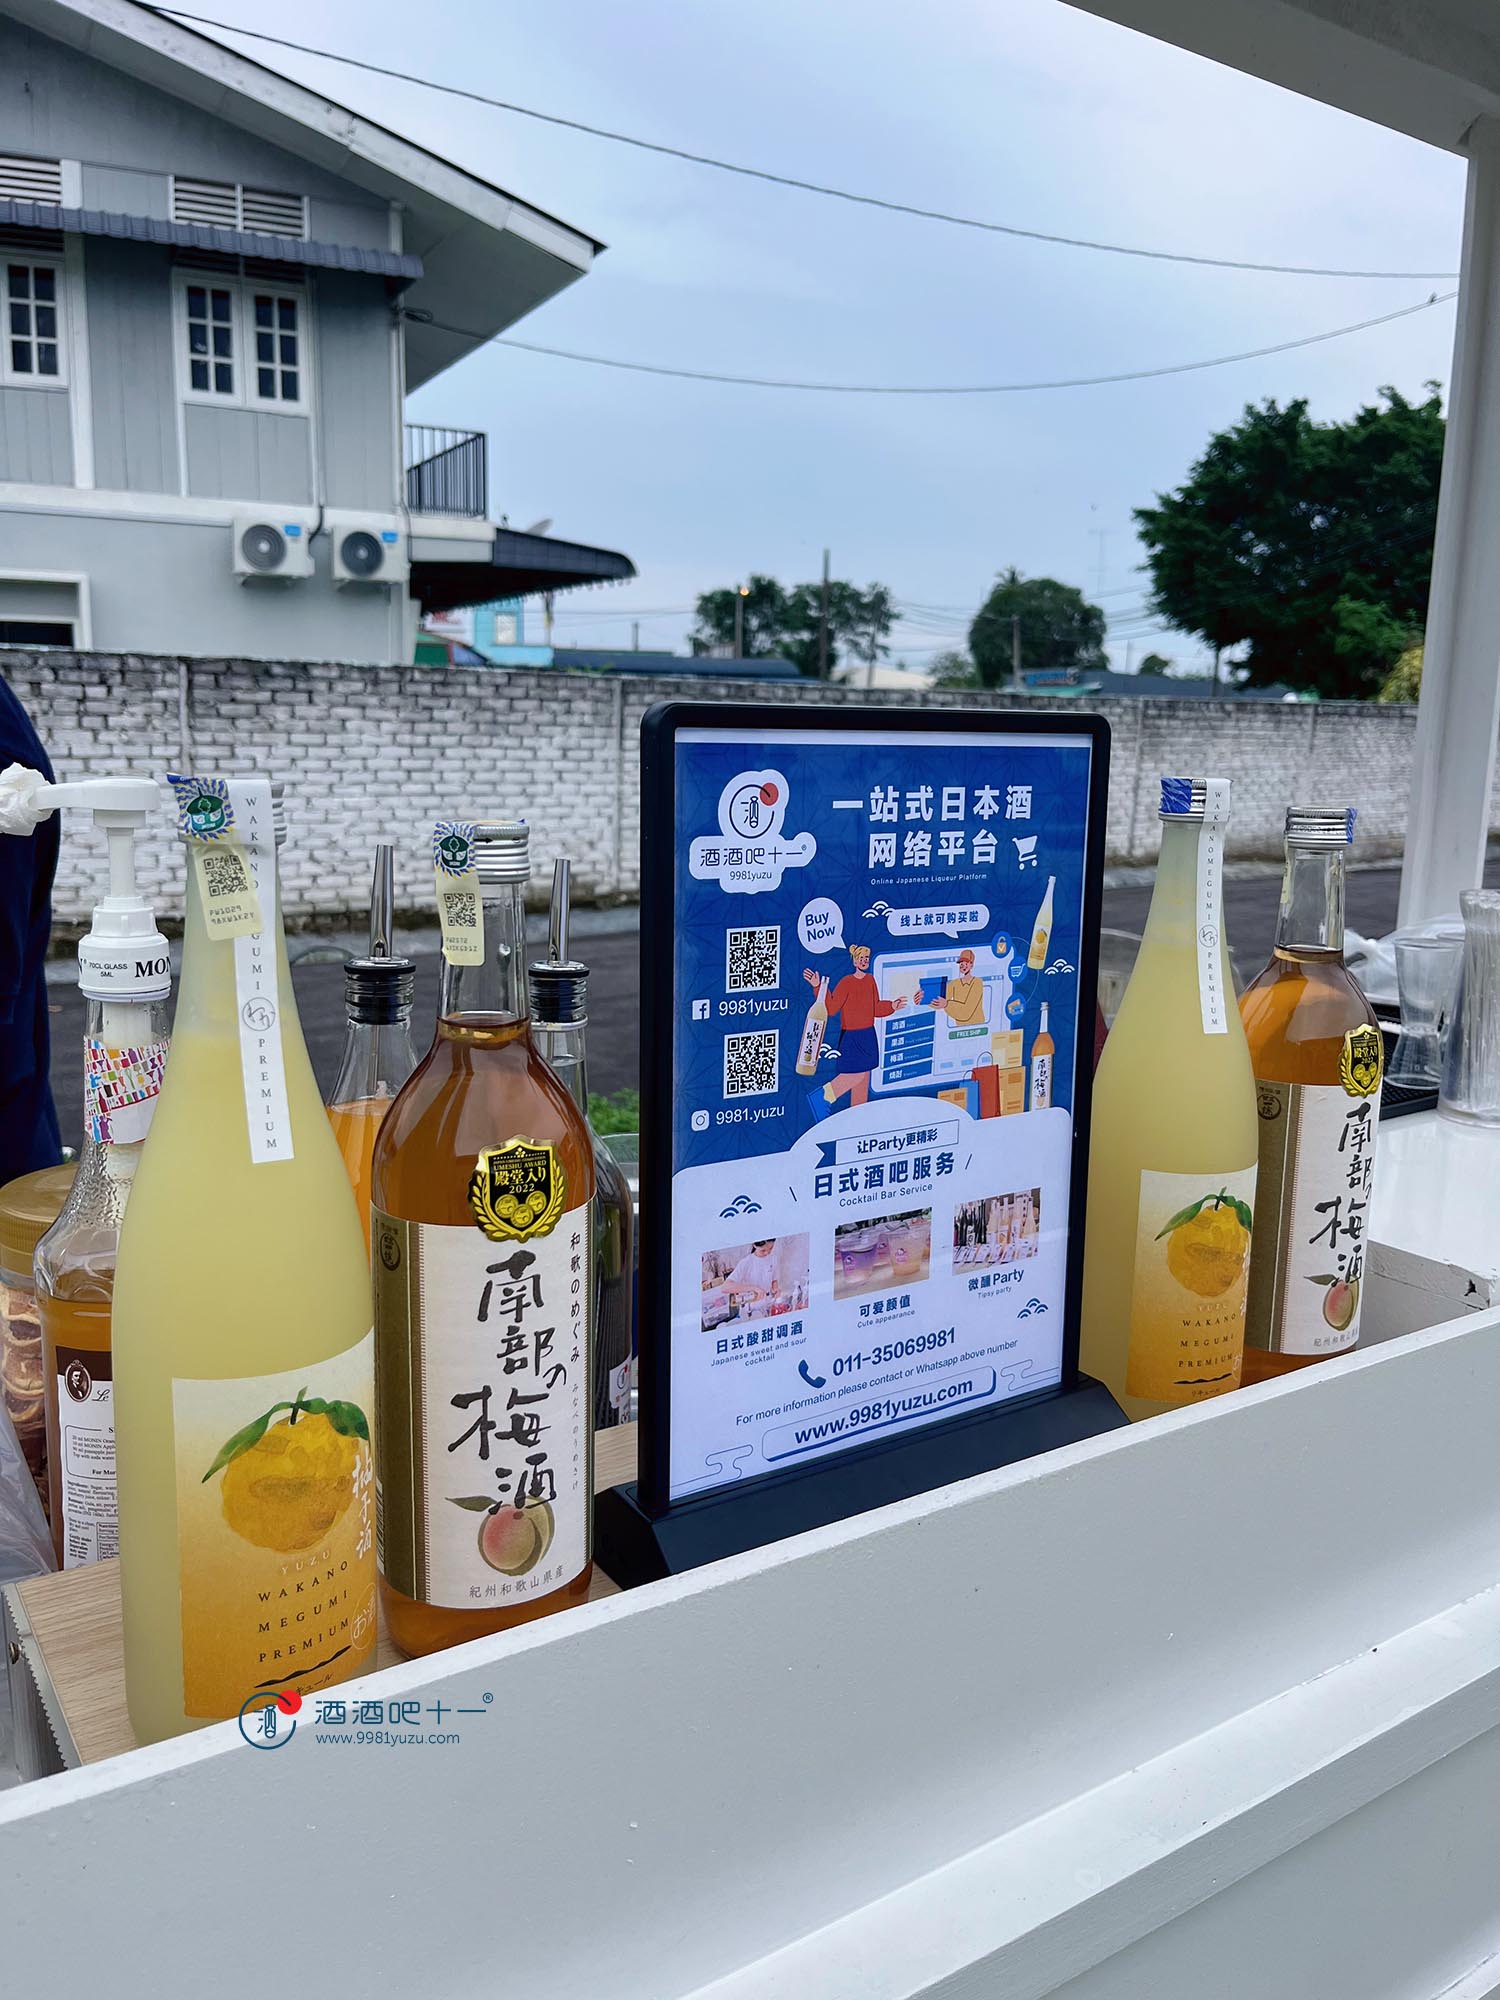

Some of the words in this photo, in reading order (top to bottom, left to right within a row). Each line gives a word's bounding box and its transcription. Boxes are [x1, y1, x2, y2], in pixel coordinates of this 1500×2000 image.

[832, 784, 1033, 823] 一站式日本酒
[868, 828, 998, 869] 网络平台
[729, 870, 772, 882] 9981yuzu
[871, 877, 894, 886] Online
[896, 876, 929, 885] Japanese
[931, 874, 957, 883] Liqueur
[959, 873, 987, 881] Platform
[805, 912, 830, 927] Buy
[900, 910, 979, 927] 线上就可购买啦
[807, 925, 836, 942] Now
[719, 999, 788, 1016] 9981yuzu
[258, 1038, 277, 1148] PREMIUM
[716, 1106, 785, 1125] 9981.yuzu
[857, 1128, 938, 1154] 让Party更精彩
[495, 1166, 547, 1186] 殿堂入り
[524, 1160, 547, 1168] AWARD
[814, 1152, 955, 1199] 日式酒吧服务
[509, 1184, 535, 1194] 2022
[839, 1192, 878, 1207] Cocktail
[880, 1189, 896, 1200] Bar
[899, 1183, 933, 1196] Service
[570, 1232, 581, 1363] 和歌のめぐみ
[978, 1291, 994, 1299] Tipsy
[995, 1286, 1012, 1295] party
[859, 1294, 911, 1317] 可爱颜值
[857, 1319, 873, 1329] Cute
[875, 1310, 915, 1324] appearance
[1182, 1313, 1236, 1327] WAKANO
[717, 1320, 803, 1354] 日式酸甜调酒
[1180, 1333, 1233, 1347] MEGUMI
[711, 1352, 748, 1367] Japanese
[751, 1345, 773, 1356] sweet
[775, 1340, 789, 1351] and
[791, 1337, 807, 1346] sour
[744, 1353, 775, 1367] cocktail
[833, 1327, 956, 1377] 011-35069981
[1178, 1353, 1233, 1367] PREMIUM
[448, 1250, 568, 1515] 南部の梅酒
[736, 1413, 754, 1426] For
[755, 1405, 781, 1420] more
[783, 1389, 836, 1412] information
[837, 1382, 868, 1399] please
[869, 1370, 903, 1387] contact
[904, 1368, 914, 1378] or
[915, 1356, 958, 1375] Whatsapp
[959, 1349, 985, 1362] above
[986, 1339, 1018, 1354] number
[794, 1380, 973, 1444] www.9981yuzu.com
[281, 1549, 332, 1575] YUZU
[258, 1560, 349, 1602] WAKANO
[469, 1564, 564, 1598] 紀州和歌山県産
[258, 1590, 349, 1633] MEGUMI
[258, 1617, 349, 1662] PREMIUM
